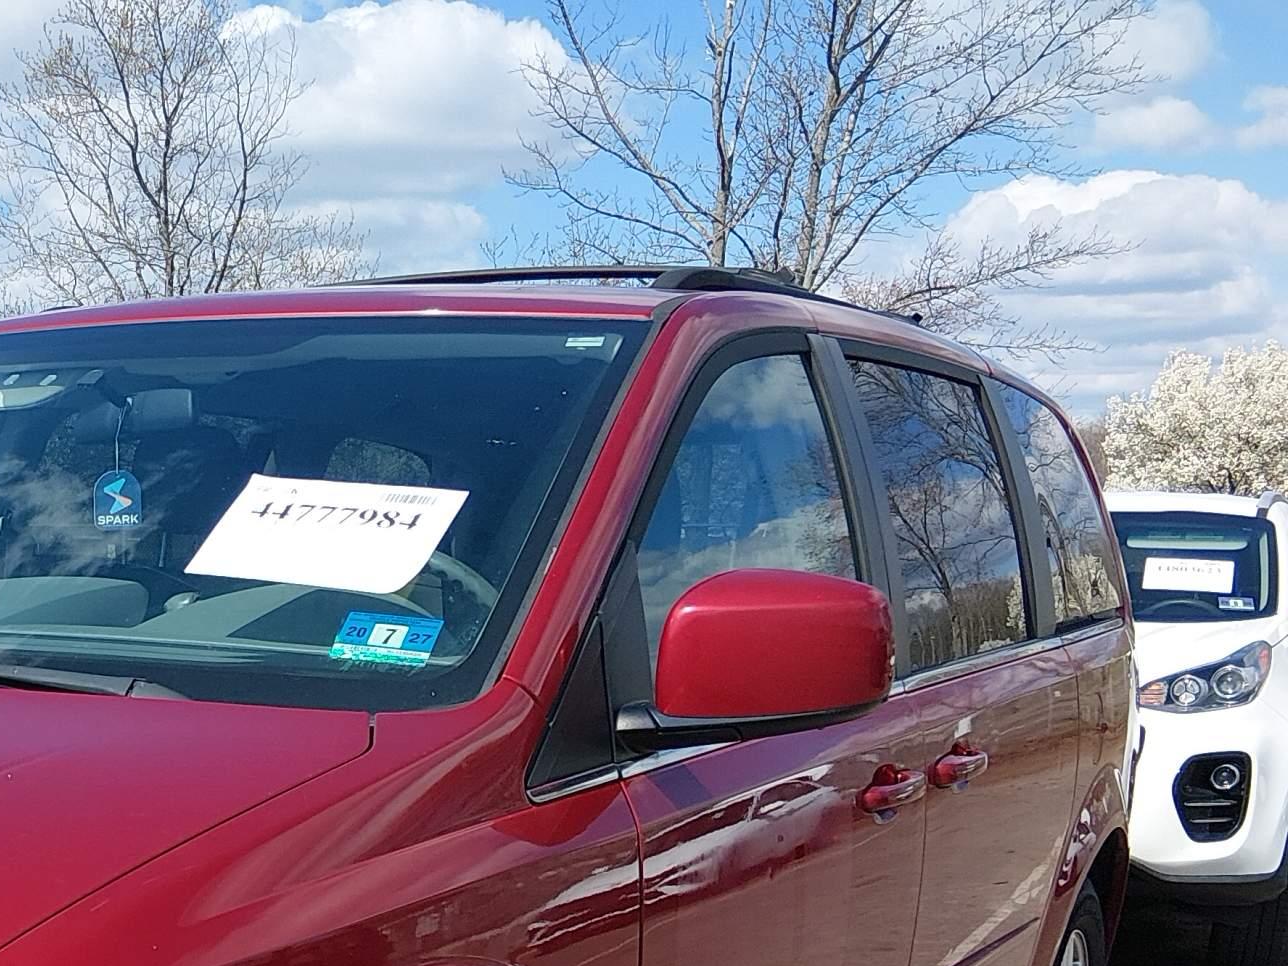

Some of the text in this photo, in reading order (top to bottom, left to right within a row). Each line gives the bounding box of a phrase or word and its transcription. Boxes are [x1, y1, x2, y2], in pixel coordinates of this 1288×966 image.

[97, 514, 139, 525] SPARK
[251, 501, 423, 530] 44777984
[345, 626, 434, 645] 20 7 27
